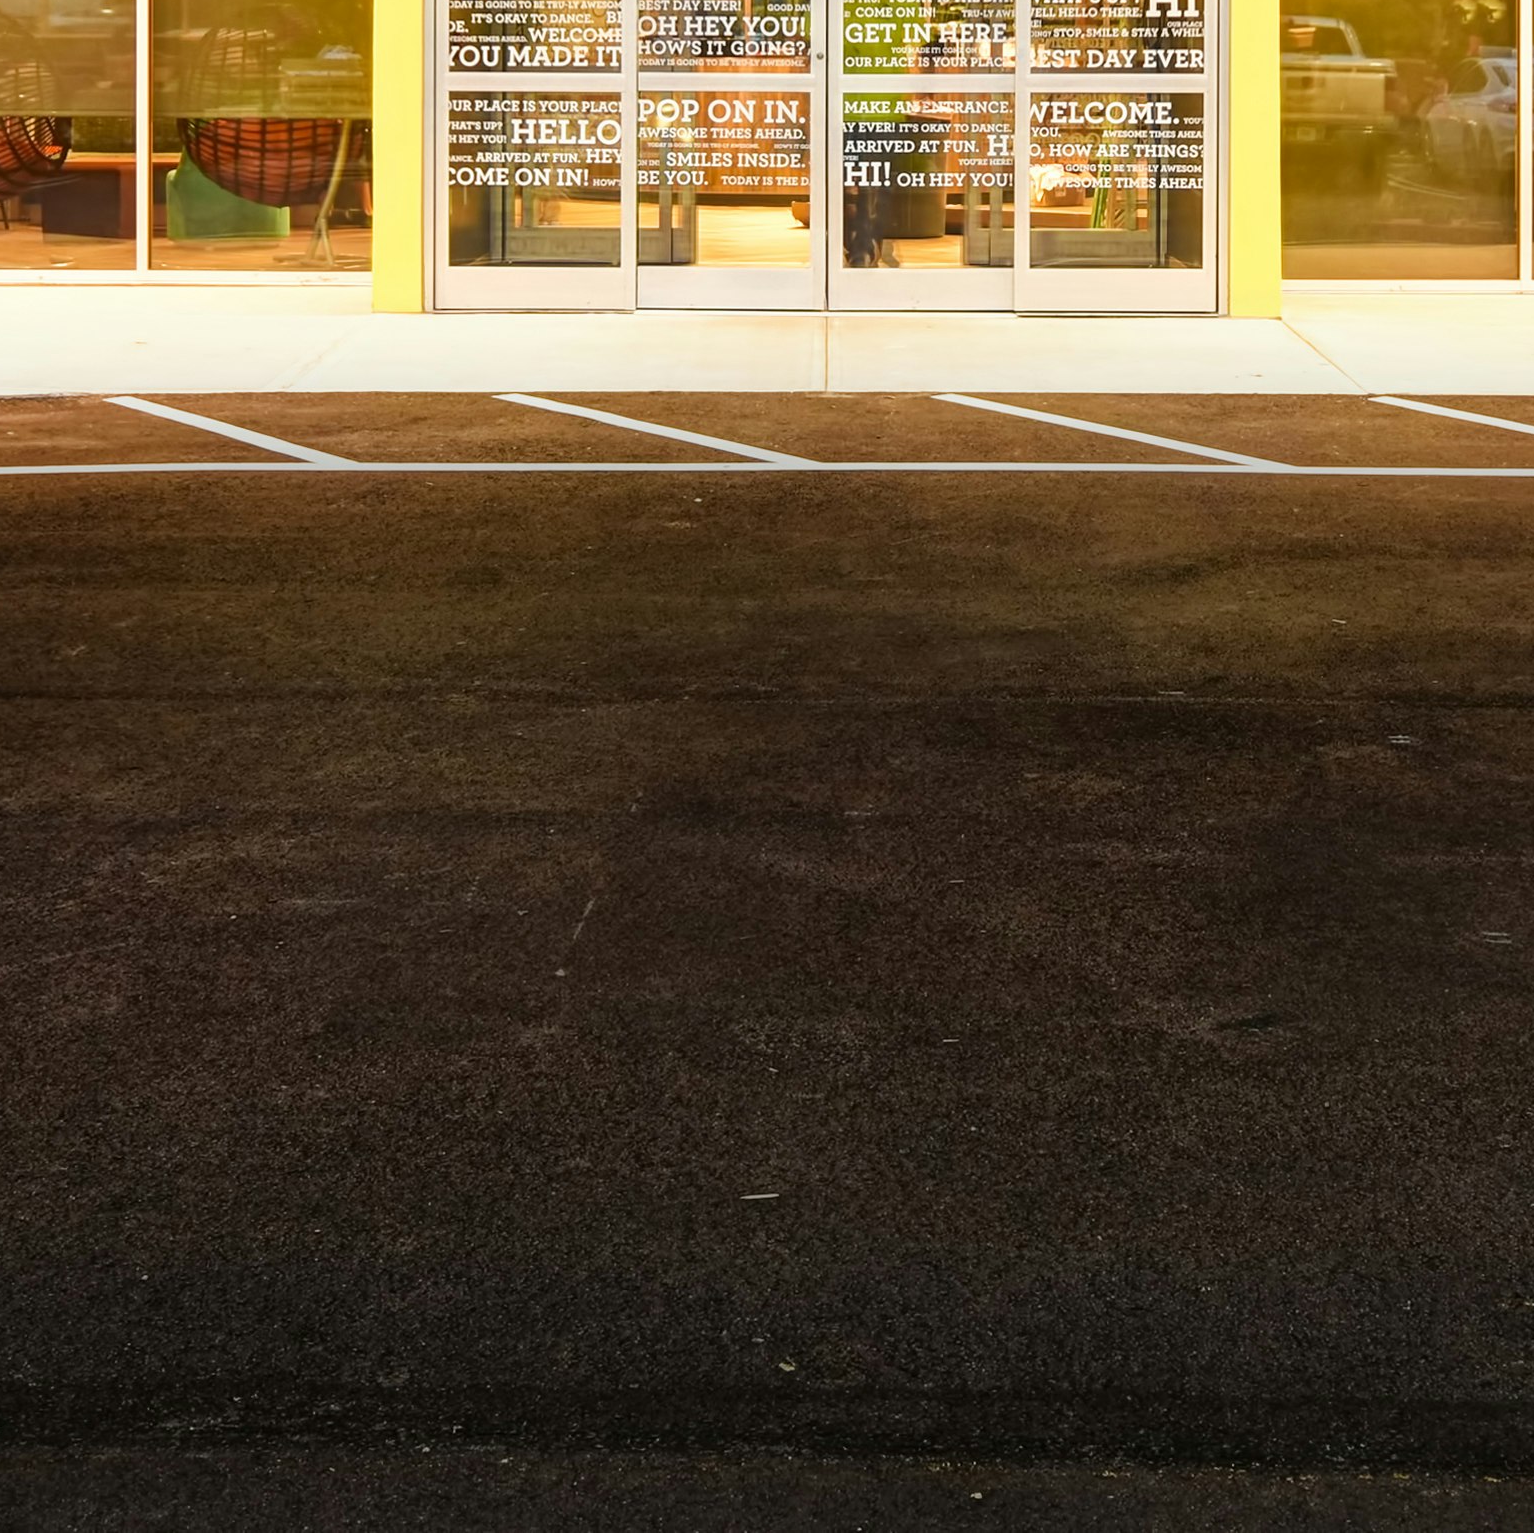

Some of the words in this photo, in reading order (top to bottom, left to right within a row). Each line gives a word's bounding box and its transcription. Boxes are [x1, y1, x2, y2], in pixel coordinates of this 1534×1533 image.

[475, 0, 483, 8] IS
[485, 0, 517, 9] GOING
[519, 0, 532, 9] TO
[534, 0, 545, 8] BE
[638, 0, 670, 11] BEST
[673, 0, 700, 11] DAY
[703, 0, 741, 11] EVER!
[856, 8, 893, 17] COME
[896, 8, 915, 17] ON
[918, 8, 936, 17] IN!
[1058, 7, 1097, 17] HELLO
[471, 14, 493, 23] IT'S
[495, 14, 528, 23] OKAY
[530, 14, 547, 23] TO
[550, 14, 594, 23] DANCE.
[638, 16, 677, 36] OH
[684, 16, 737, 36] HEY
[743, 17, 806, 36] YOU!
[845, 24, 896, 43] GET
[903, 24, 930, 43] IN
[1053, 28, 1084, 38] STOP,
[1086, 28, 1119, 37] SMILE
[1121, 29, 1129, 37] &
[1131, 28, 1159, 38] STAY
[1161, 28, 1169, 38] A
[1171, 28, 1203, 38] WHIL
[638, 40, 702, 55] HOW'S
[707, 41, 726, 55] IT
[731, 41, 805, 56] GOING?
[508, 46, 589, 66] MADE
[596, 46, 621, 66] IT
[845, 57, 872, 67] OUR
[875, 57, 915, 67] PLACE
[918, 57, 929, 67] IS
[932, 57, 967, 67] YOUR
[1087, 50, 1137, 68] DAY
[1143, 50, 1203, 68] EVER
[449, 100, 472, 112] UR
[474, 100, 518, 112] PLACE
[522, 100, 535, 112] IS
[538, 101, 578, 112] YOUR
[581, 101, 621, 112] PLAC
[638, 99, 699, 123] POP
[708, 100, 756, 123] ON
[764, 100, 806, 124] IN.
[844, 101, 890, 113] MAKE
[923, 101, 1013, 113] ENTRANCE.
[1030, 102, 1180, 125] WELCOME.
[449, 121, 481, 130] HAT'S
[483, 121, 503, 130] UP?
[859, 123, 895, 132] EVER!
[899, 124, 919, 132] IT'S
[921, 124, 951, 132] OKAY
[954, 124, 969, 132] TO
[971, 124, 1012, 133] DANCE.
[511, 119, 622, 145] HELLO
[638, 127, 707, 138] AWESOME
[710, 128, 752, 139] TIMES
[755, 129, 806, 139] AHEAD.
[1031, 127, 1061, 137] YOU.
[1103, 130, 1147, 138] AWESOME
[459, 135, 479, 143] HEY
[482, 135, 507, 143] YOU!
[844, 141, 915, 153] ARRIVED
[919, 141, 940, 153] AT
[943, 141, 979, 153] FUN.
[1049, 144, 1093, 157] HOW
[1097, 144, 1129, 157] ARE
[476, 152, 530, 162] ARRIVED
[533, 153, 550, 162] AT
[552, 153, 580, 163] FUN.
[667, 153, 732, 167] SMILES
[737, 153, 806, 167] INSIDE.
[515, 168, 552, 186] ON
[556, 169, 589, 186] IN!
[638, 171, 660, 184] BE
[664, 171, 708, 185] YOU.
[721, 176, 761, 185] TODAY
[763, 177, 773, 185] IS
[775, 177, 798, 185] THE
[844, 162, 891, 187] HI!
[897, 173, 925, 187] OH
[929, 173, 966, 187] HEY
[970, 173, 1013, 187] YOU!
[1115, 178, 1156, 188] TIMES
